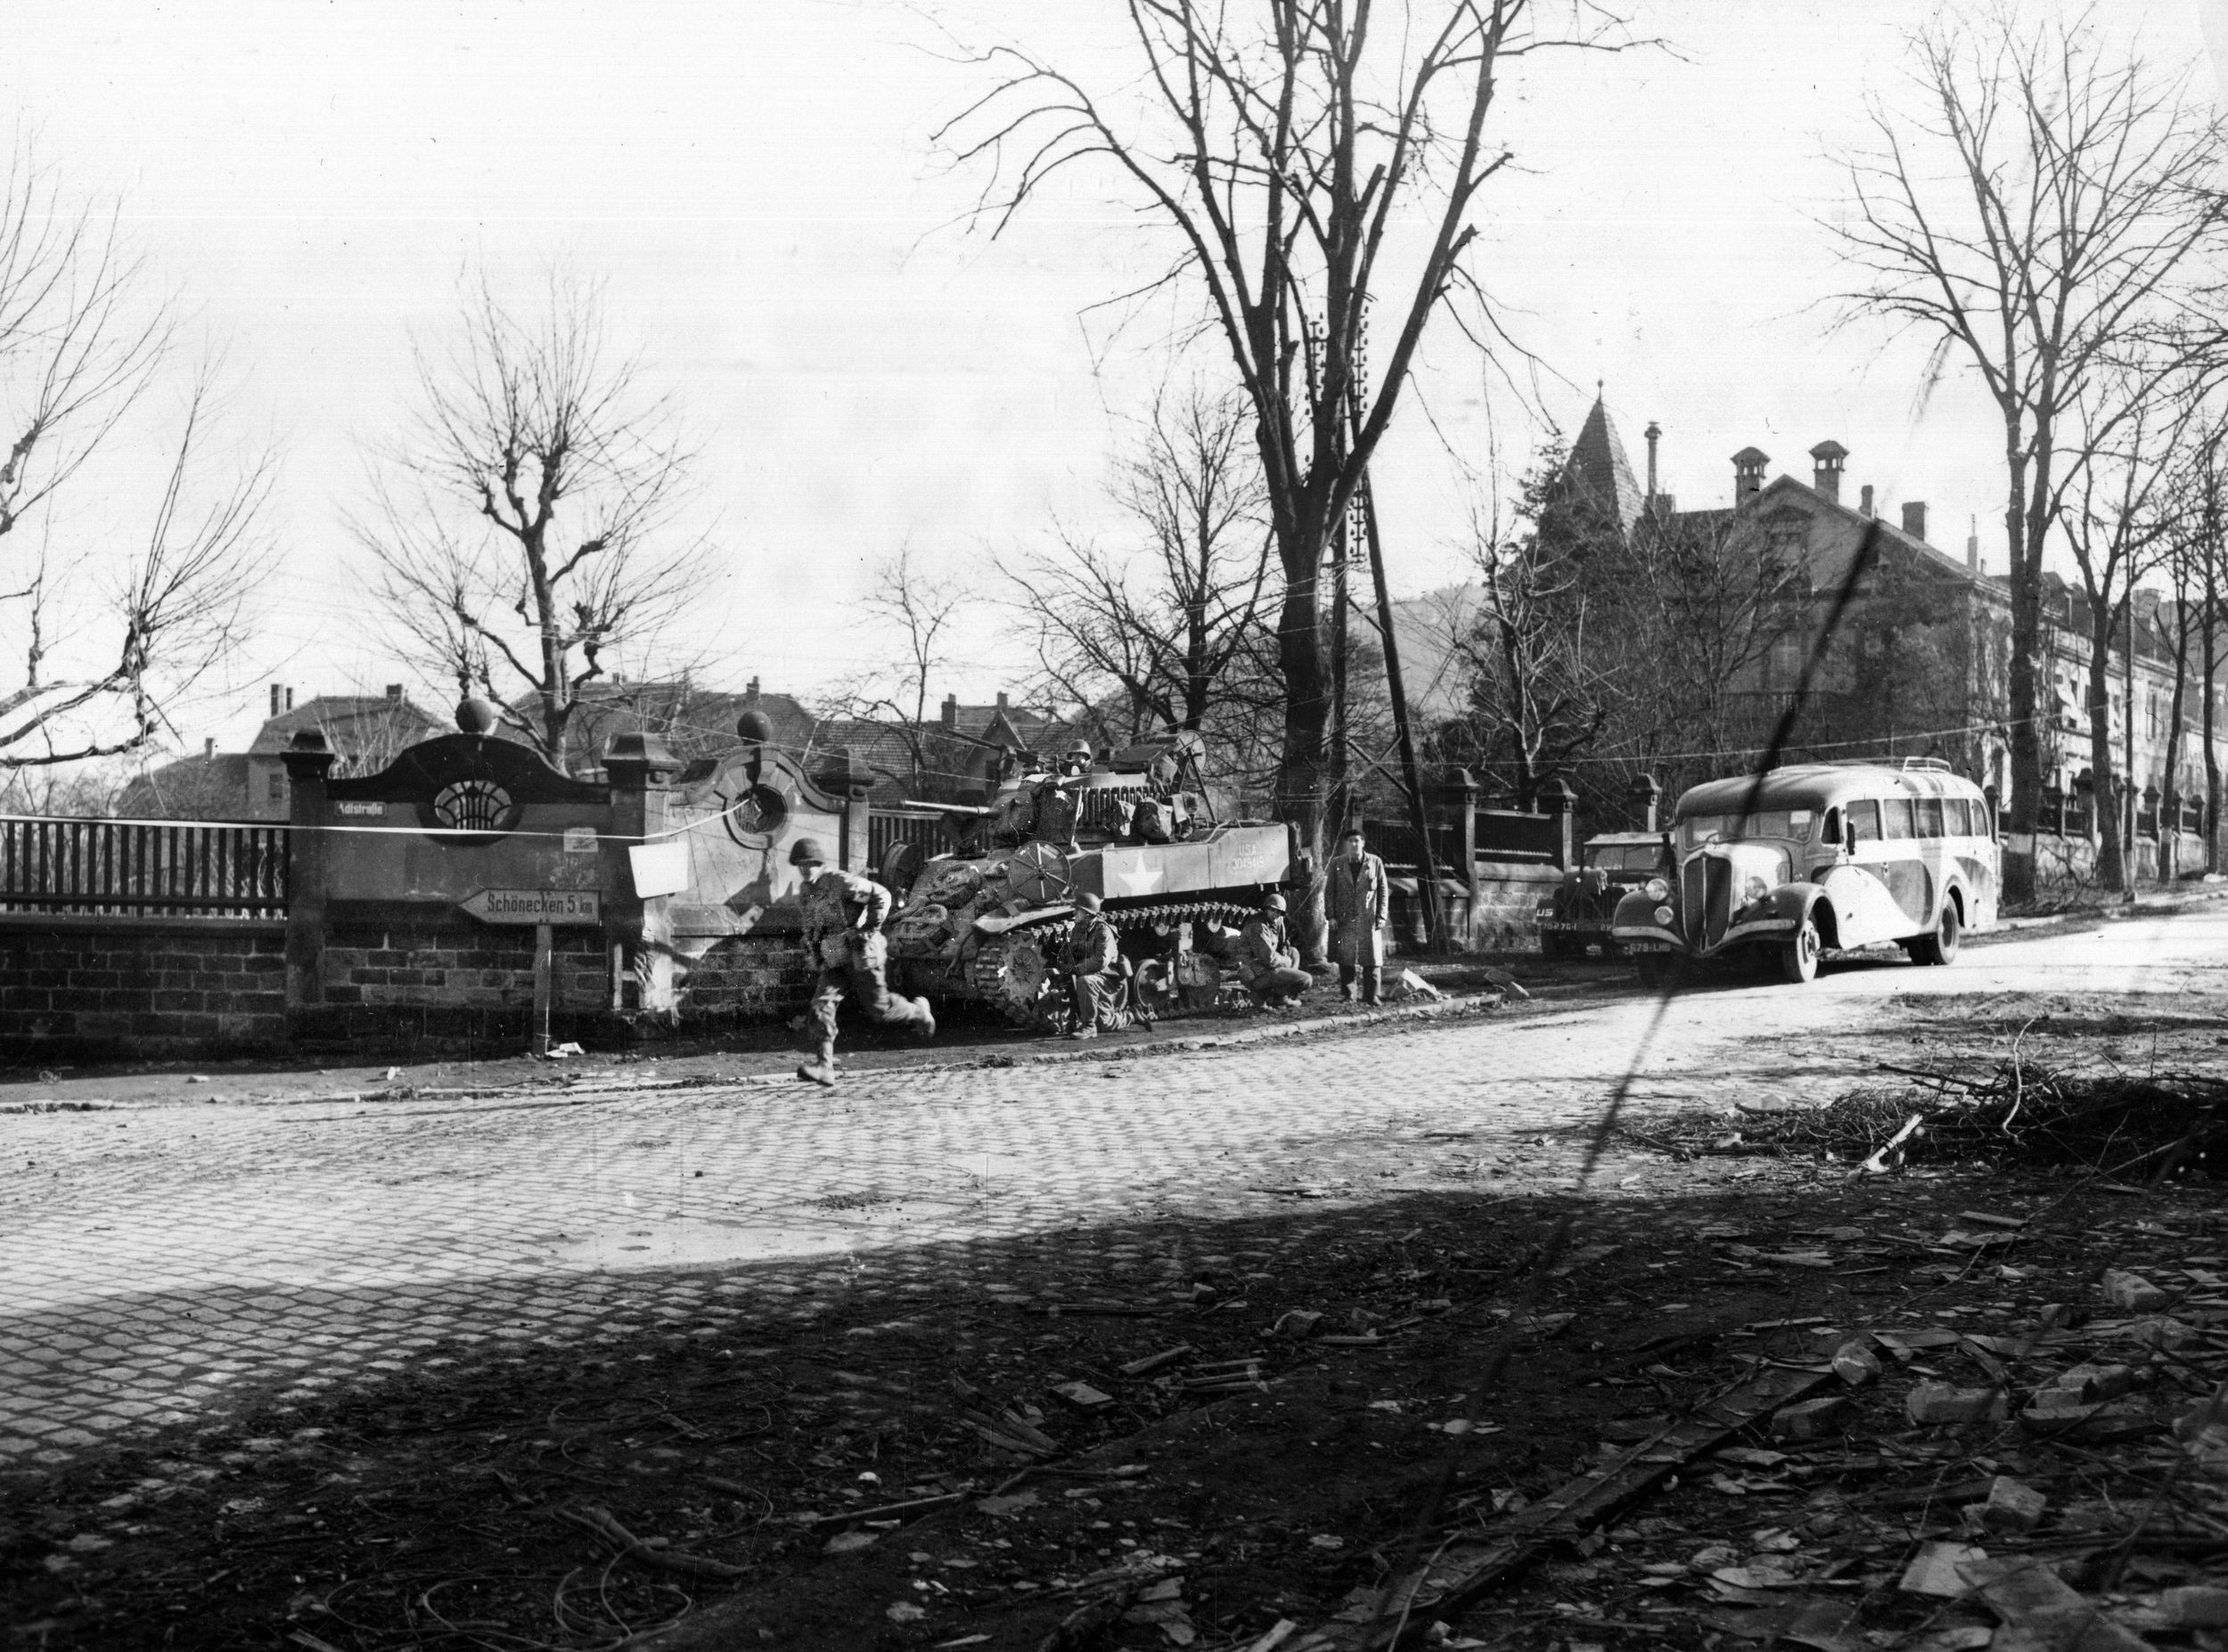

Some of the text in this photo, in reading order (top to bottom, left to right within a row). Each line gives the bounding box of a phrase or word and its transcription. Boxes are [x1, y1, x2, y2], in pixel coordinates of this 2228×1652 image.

[487, 892, 593, 914] Schönecken 5 km
[1536, 908, 1554, 917] US
